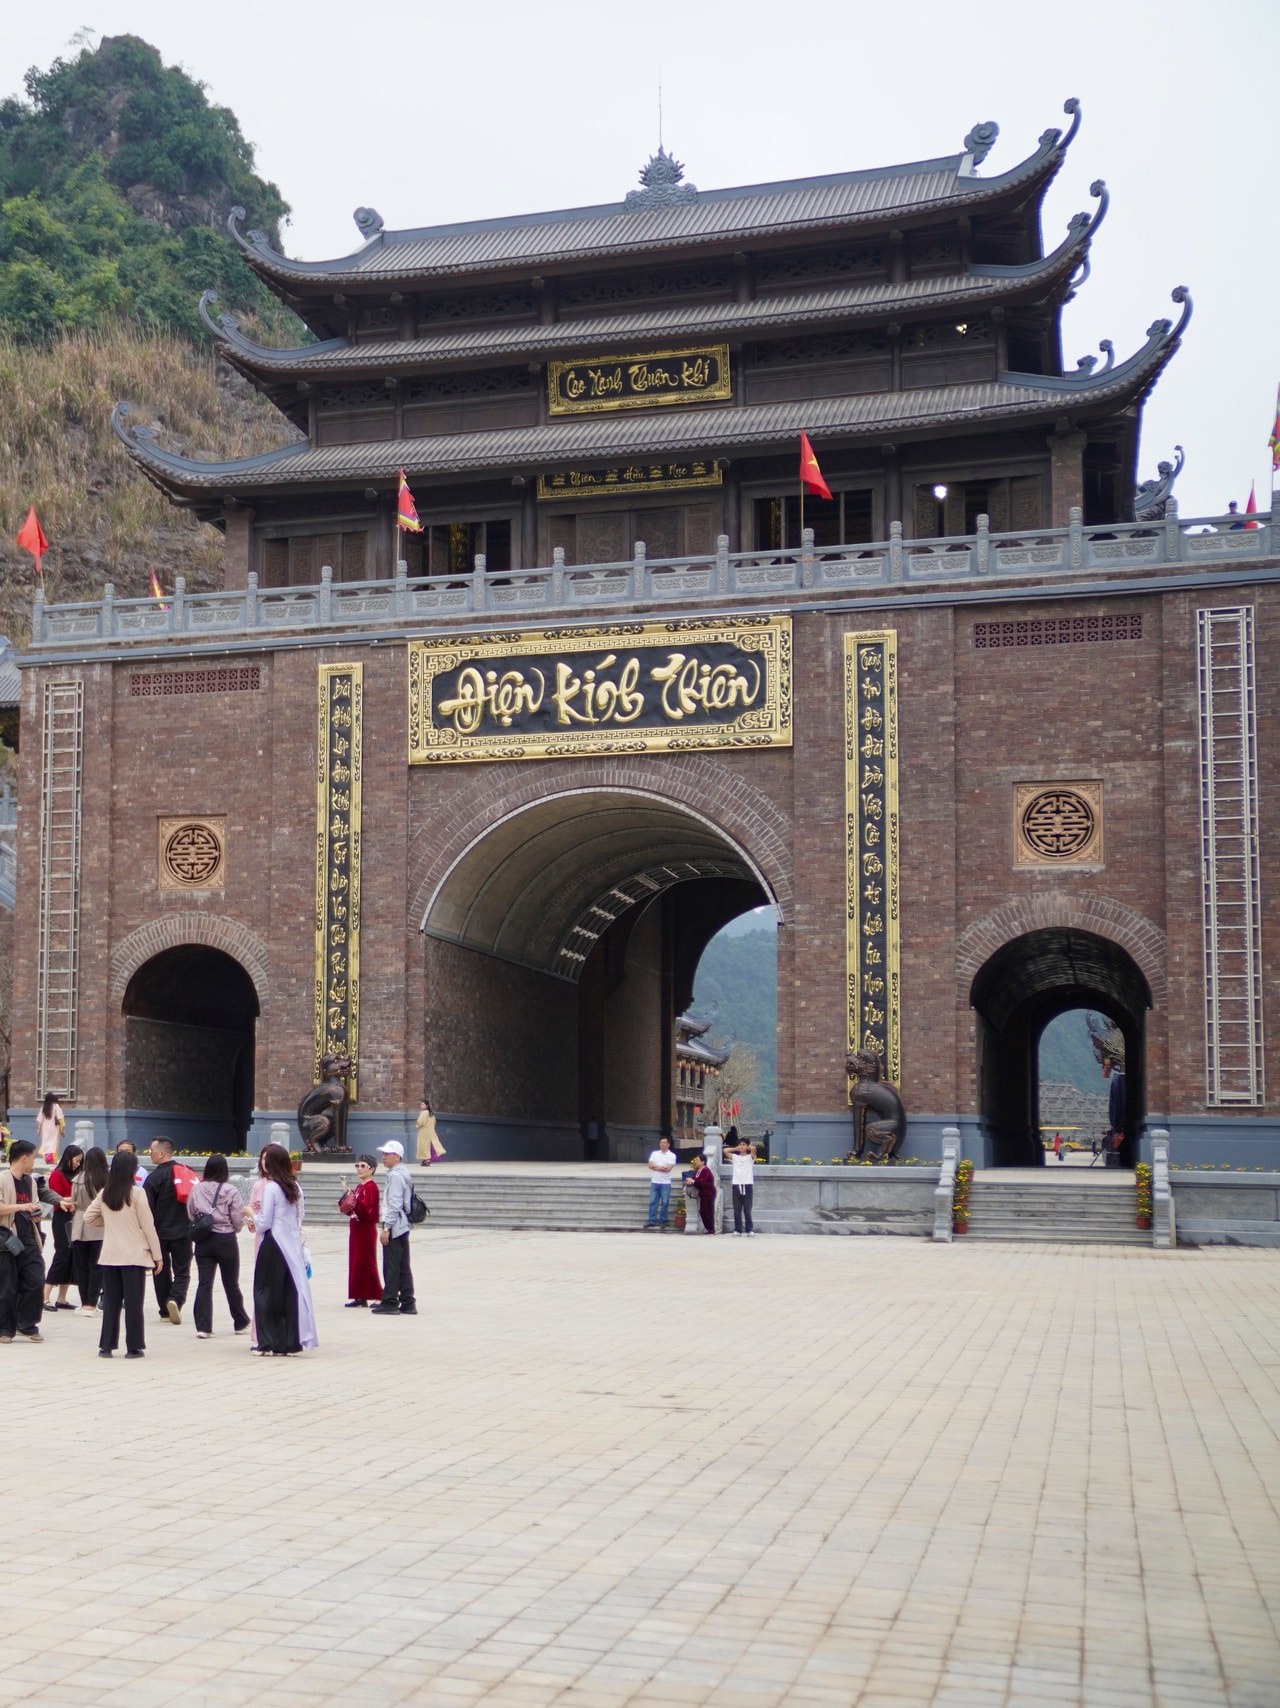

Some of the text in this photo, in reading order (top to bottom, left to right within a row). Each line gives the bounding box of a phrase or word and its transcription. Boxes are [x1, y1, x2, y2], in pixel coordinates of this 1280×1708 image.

[566, 358, 711, 398] Cao Xanh Thuận Khí
[860, 648, 881, 672] Tràng
[333, 678, 350, 699] Bái
[438, 653, 761, 734] Điện Kính Thiên
[862, 677, 881, 700] An
[332, 706, 351, 727] Đính
[861, 707, 882, 731] Đền
[861, 734, 883, 758] Đài
[862, 765, 883, 788] Bền
[331, 788, 351, 813] Kính
[331, 815, 349, 838] Địa
[864, 881, 882, 904] Hộ
[333, 896, 346, 921] Vạn
[866, 942, 881, 965] Gia
